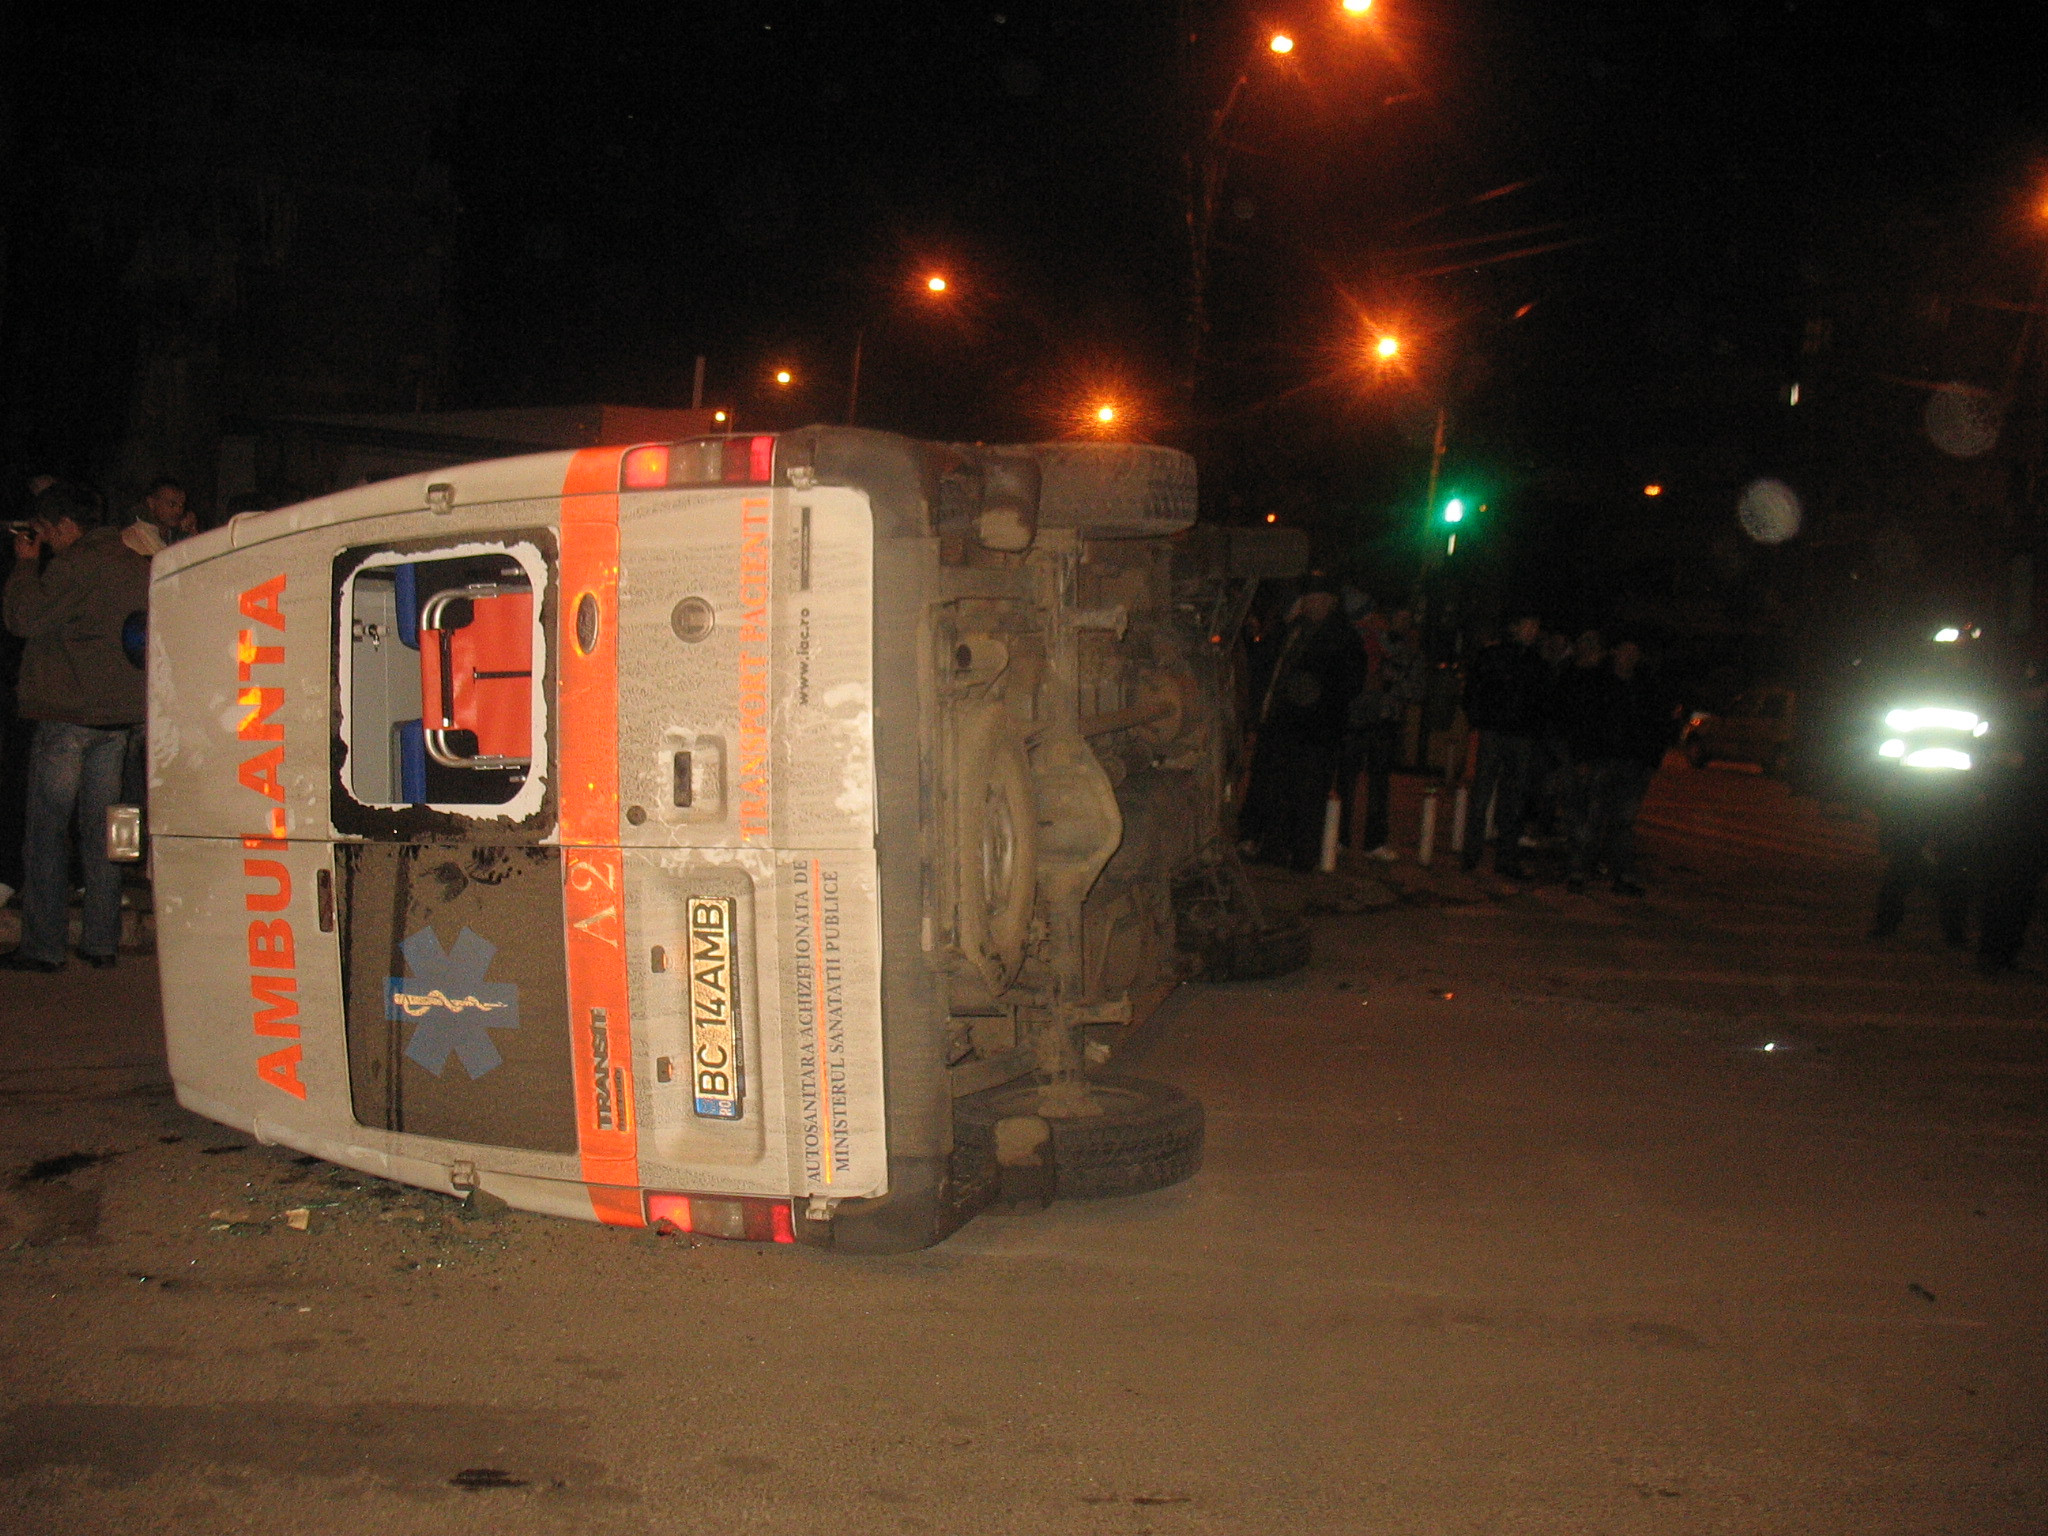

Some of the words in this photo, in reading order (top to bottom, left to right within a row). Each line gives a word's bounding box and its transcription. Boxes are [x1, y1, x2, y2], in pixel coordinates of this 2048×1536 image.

[741, 496, 769, 642] PACIENTI
[796, 607, 811, 706] www.iac.ro
[740, 649, 767, 841] TRANSPORT
[238, 573, 306, 1100] AMBULANTA
[792, 860, 809, 884] DE
[794, 890, 814, 1038] ACHIZITIONATA
[822, 870, 840, 952] PUBLICE
[825, 958, 844, 1055] SANATATII
[591, 1009, 612, 1130] TRANSIT
[699, 1044, 728, 1096] BC
[719, 1100, 733, 1117] RO
[798, 1042, 820, 1183] AUTOSANITARA
[830, 1057, 850, 1173] MINISTERUL
